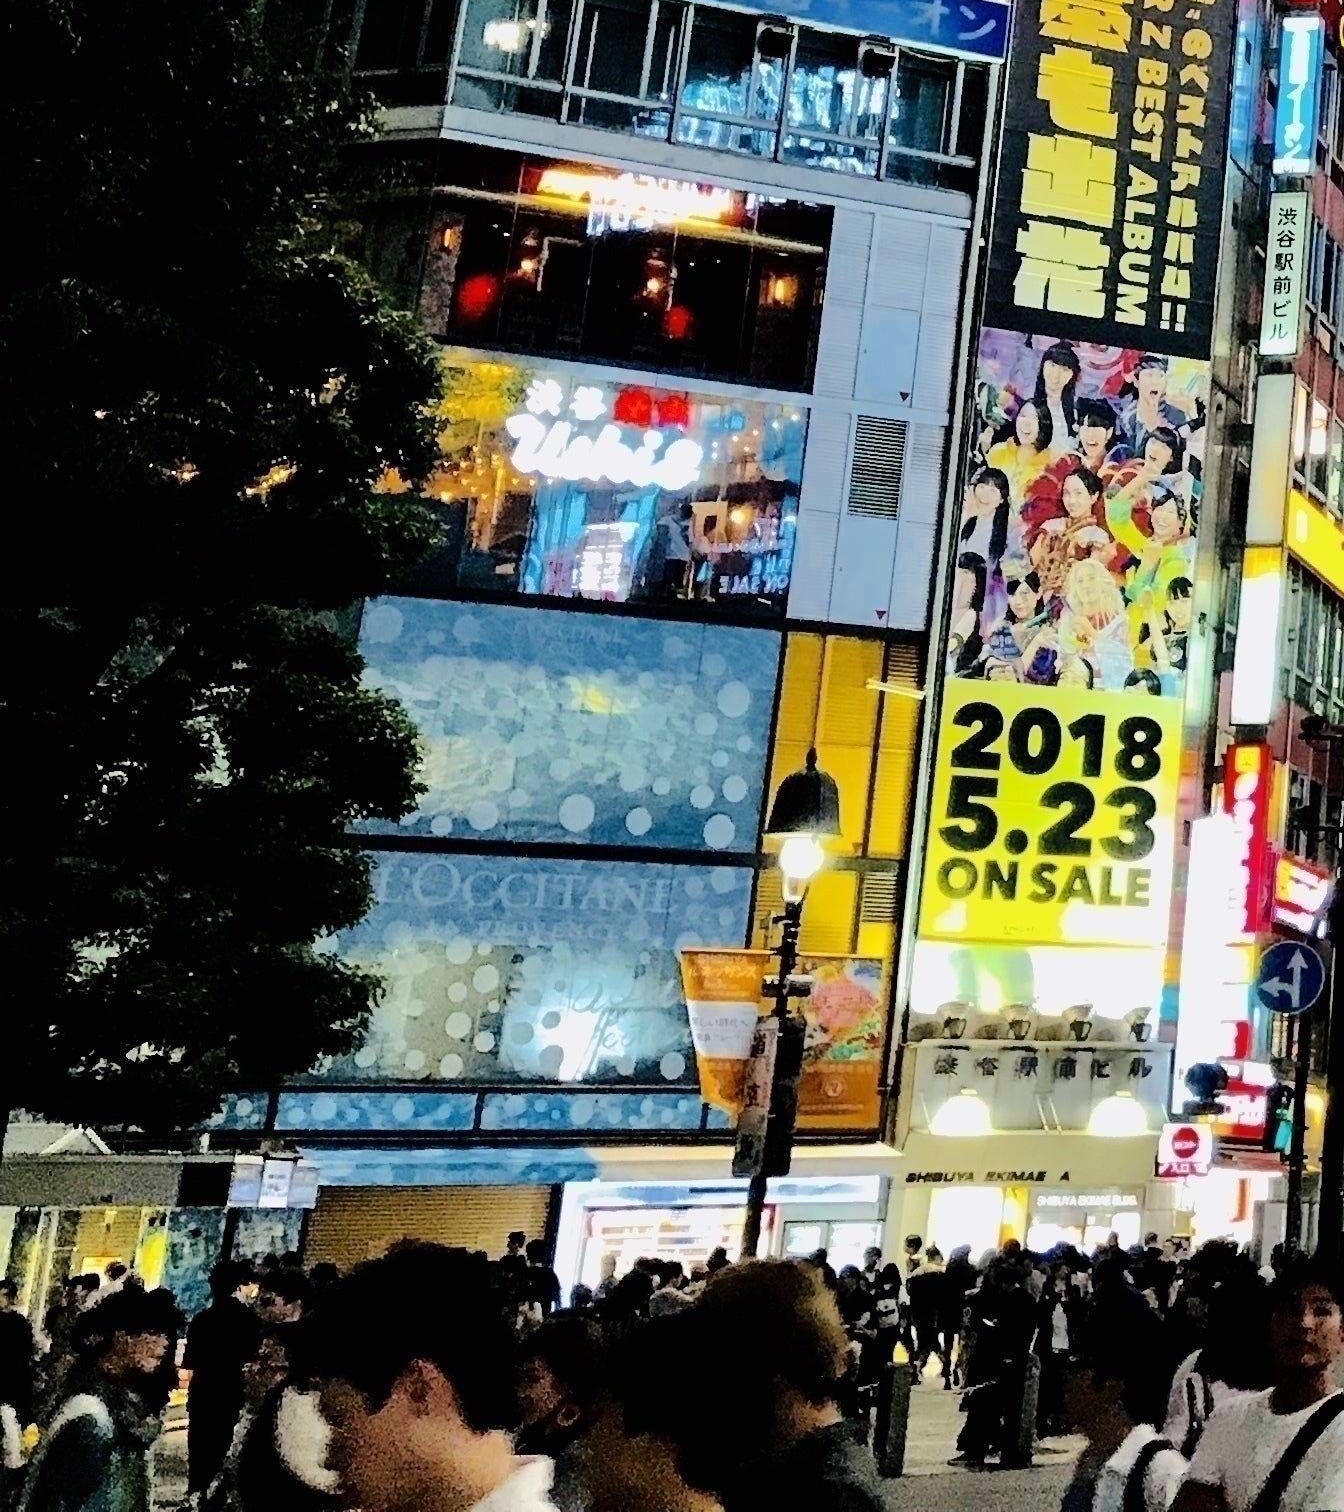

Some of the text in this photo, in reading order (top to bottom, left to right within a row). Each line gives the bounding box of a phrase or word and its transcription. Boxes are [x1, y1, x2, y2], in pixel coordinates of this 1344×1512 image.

[1139, 22, 1173, 51] Z
[1127, 58, 1169, 162] BEST
[1114, 165, 1159, 326] ALBUM
[1268, 207, 1298, 341] 渋谷駅前ビル
[951, 702, 1163, 782] 2018
[938, 775, 1157, 862] 5.23
[936, 857, 1152, 908] ON SALE
